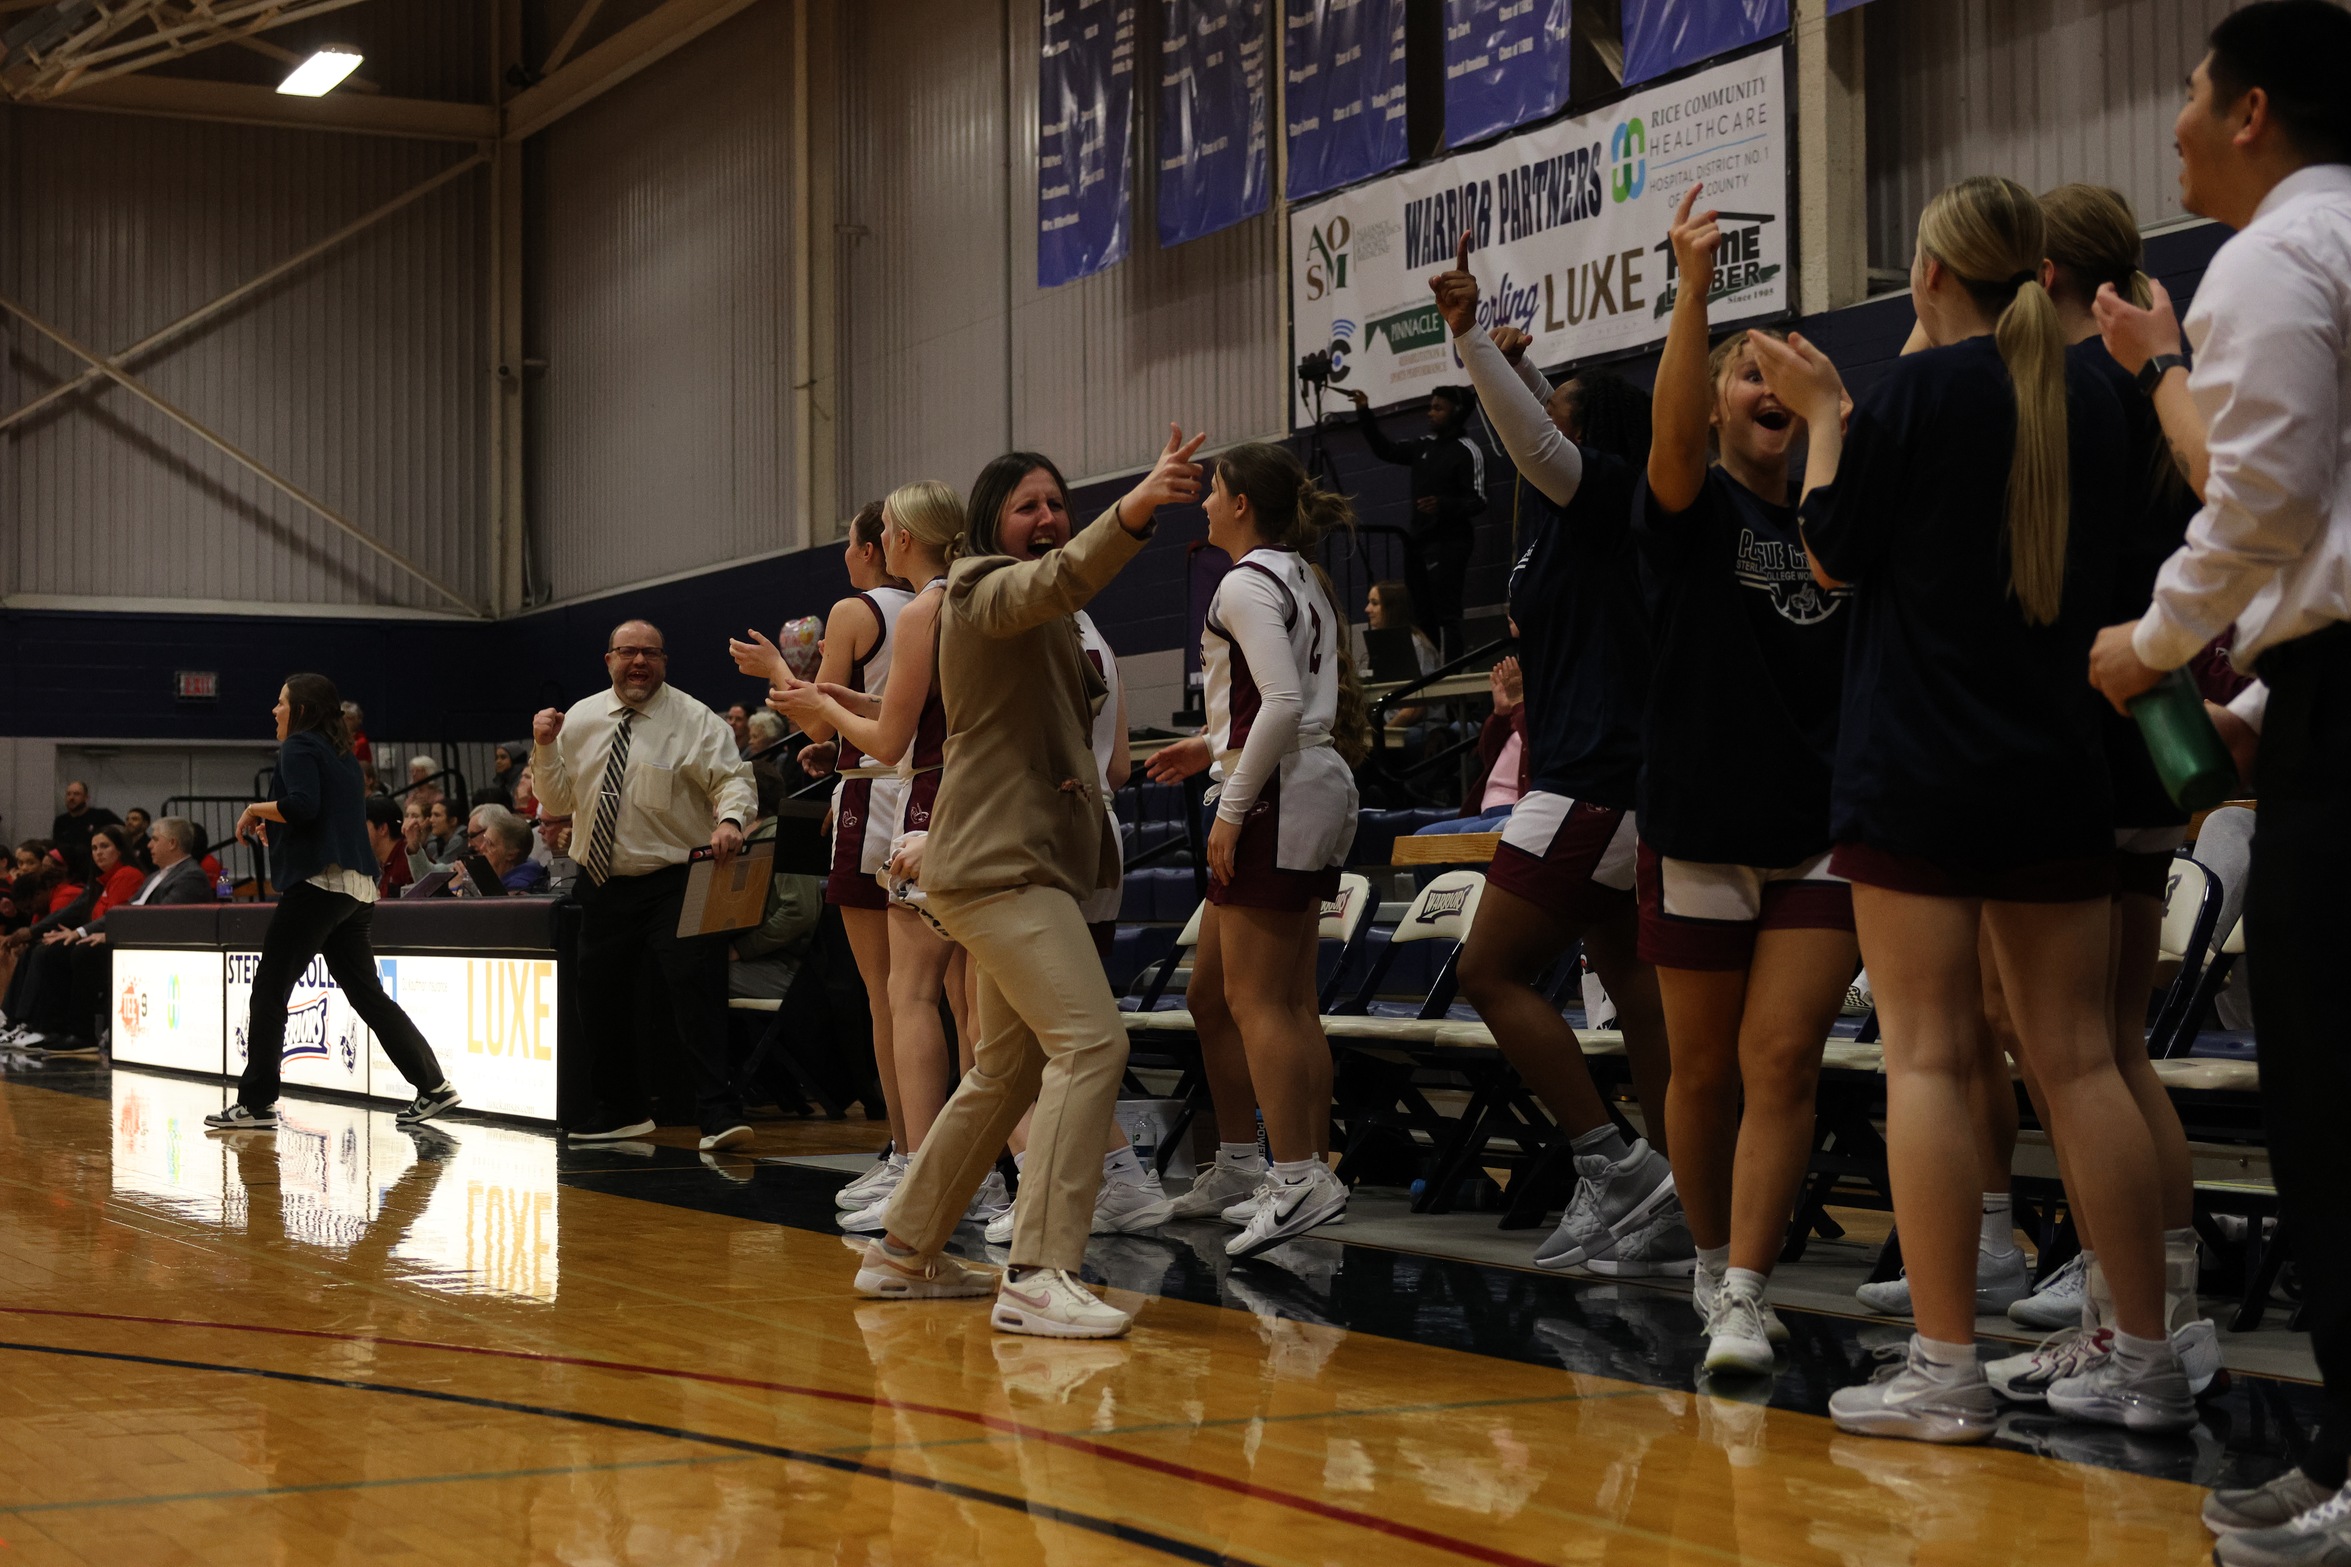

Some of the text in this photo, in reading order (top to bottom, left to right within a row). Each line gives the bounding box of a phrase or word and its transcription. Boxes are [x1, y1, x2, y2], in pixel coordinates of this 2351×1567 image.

[1651, 75, 1768, 128] RICE COMMUNITY
[1649, 103, 1768, 157] HEALTHCARE
[1649, 169, 1694, 194] HOSPITAL
[1697, 154, 1741, 180] DISTRICT
[1706, 172, 1750, 198] COUNTY
[1404, 180, 1492, 270] WARRIOR
[1498, 141, 1603, 245] PARTNERS
[1545, 247, 1646, 333] LUXE
[1665, 261, 1762, 308] LBER
[1391, 312, 1440, 342] PINNACLE
[1766, 570, 1796, 582] OLLEGE
[1309, 602, 1322, 675] 2
[1425, 887, 1468, 913] WARRIORS
[466, 959, 553, 1062] LUXE
